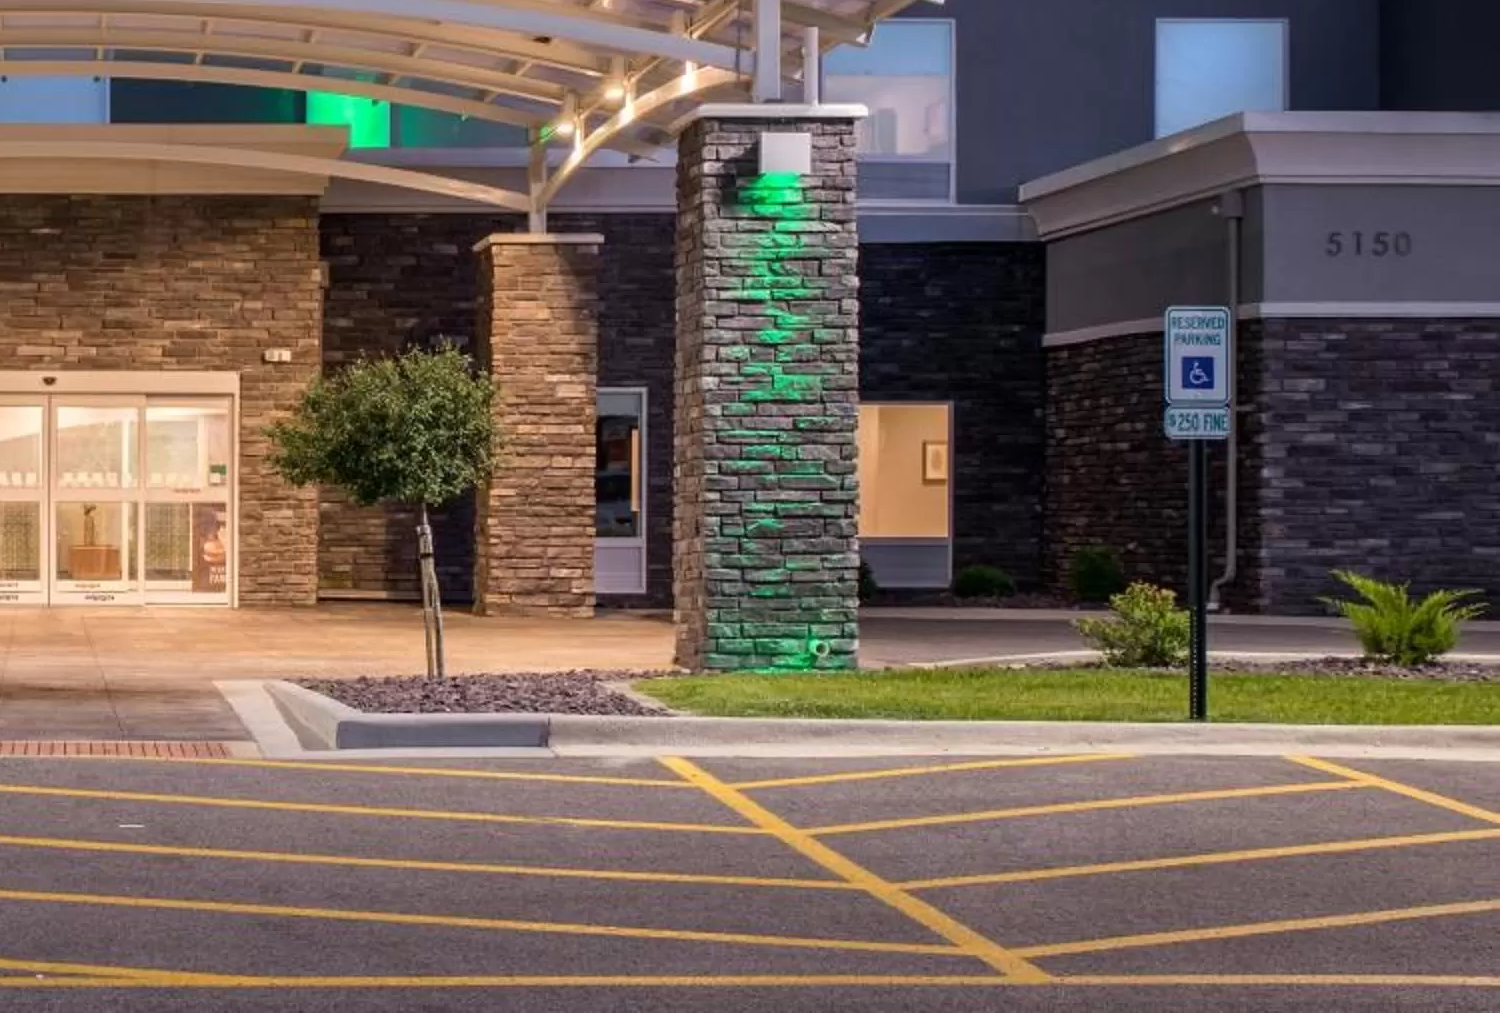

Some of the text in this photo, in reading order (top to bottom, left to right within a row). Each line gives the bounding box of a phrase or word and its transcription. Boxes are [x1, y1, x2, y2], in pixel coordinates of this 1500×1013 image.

[1325, 230, 1412, 257] 5150
[1172, 315, 1225, 330] RESERVED
[1174, 334, 1221, 346] PARKING
[1167, 413, 1229, 432] $250 FINE
